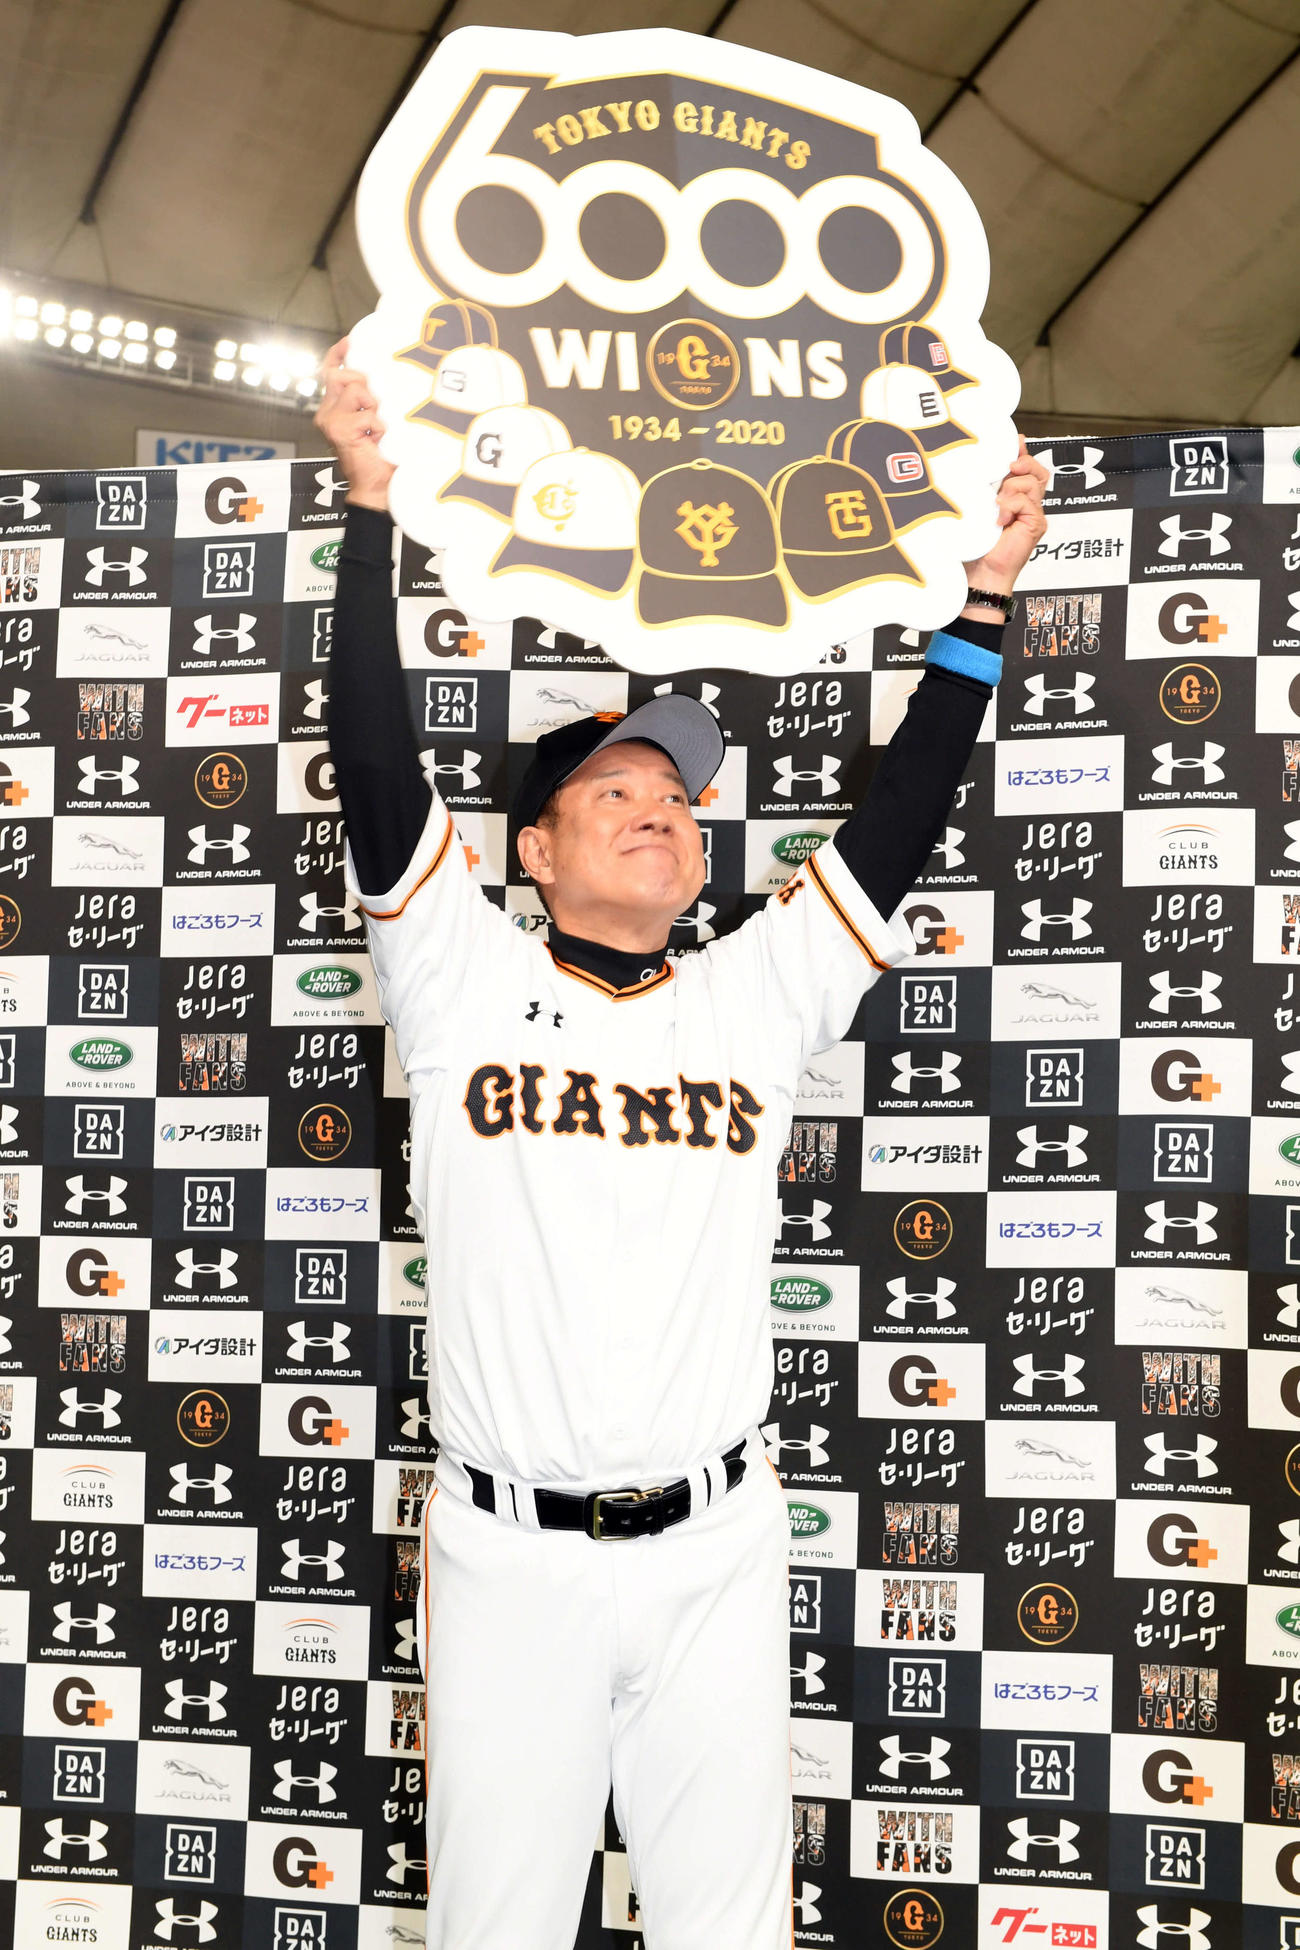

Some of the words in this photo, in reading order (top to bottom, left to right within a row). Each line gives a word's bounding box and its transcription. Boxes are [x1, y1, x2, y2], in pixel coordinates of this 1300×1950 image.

[533, 98, 660, 155] TOKYO
[673, 101, 811, 169] GIANTS
[418, 85, 935, 323] 6000
[608, 415, 682, 441] 1934
[715, 419, 785, 445] 2020
[1184, 447, 1216, 465] DA
[1185, 467, 1215, 486] ZN
[109, 486, 136, 502] DA
[108, 505, 135, 521] ZN
[1144, 564, 1186, 574] UNDER
[1189, 562, 1244, 572] ARMOUR
[73, 591, 108, 601] UNDER
[111, 592, 157, 600] ARMOUR
[1023, 594, 1102, 627] WITH
[1023, 627, 1102, 658] FANS
[73, 653, 150, 662] JAGUAR
[181, 660, 217, 669] UNDER
[220, 658, 266, 667] ARMOUR
[77, 684, 145, 712] WITH
[438, 686, 465, 703] DA
[1168, 687, 1177, 696] 19
[1203, 686, 1214, 695] 34
[230, 705, 269, 726] ネット
[438, 706, 464, 723] ZN
[77, 712, 145, 741] FANS
[1011, 722, 1051, 732] UNDER
[1055, 720, 1107, 729] ARMOUR
[1008, 768, 1110, 785] はごろもフーズ
[67, 800, 102, 809] UNDER
[105, 801, 150, 809] ARMOUR
[760, 803, 799, 812] UNDER
[803, 802, 852, 811] ARMOUR
[1169, 841, 1208, 850] CLUB
[69, 862, 145, 871] JAGUAR
[1160, 855, 1217, 869] GIANTS
[173, 914, 262, 929] はごろもフーズ
[91, 973, 117, 990] DA
[309, 970, 341, 983] LAND
[310, 979, 352, 993] ROVER
[90, 993, 116, 1009] ZN
[915, 986, 944, 1003] DA
[293, 1010, 320, 1018] ABOVE
[332, 1009, 364, 1018] BEYOND
[914, 1006, 942, 1023] ZN
[1010, 1013, 1102, 1024] JAGUAR
[1136, 1020, 1177, 1030] UNDER
[1181, 1020, 1235, 1030] ARMOUR
[81, 1043, 114, 1055] LAND
[179, 1033, 248, 1062] WITH
[81, 1052, 123, 1065] ROVER
[179, 1062, 248, 1091] FANS
[66, 1081, 92, 1089] ABOVE
[96, 1081, 100, 1089] &
[103, 1081, 135, 1089] BEYOND
[464, 1061, 765, 1156] GIANTS
[179, 1124, 262, 1141] アイダ設計
[305, 1125, 313, 1134] 19
[336, 1125, 346, 1134] 34
[1169, 1133, 1200, 1151] DA
[889, 1145, 982, 1163] アイダ設計
[1168, 1154, 1198, 1172] ZN
[196, 1186, 223, 1202] DA
[277, 1198, 368, 1212] はごろもフーズ
[196, 1206, 222, 1222] ZN
[53, 1220, 89, 1229] UNDER
[92, 1221, 137, 1231] ARMOUR
[902, 1222, 911, 1231] 19
[936, 1222, 946, 1231] 34
[1000, 1221, 1102, 1238] はごろもフーズ
[308, 1258, 335, 1275] DA
[308, 1278, 334, 1295] ZN
[775, 1281, 811, 1295] LAND
[776, 1292, 821, 1306] ROVER
[873, 1325, 913, 1335] UNDER
[917, 1326, 968, 1335] ARMOUR
[1136, 1319, 1227, 1330] JAGUAR
[173, 1338, 256, 1356] アイダ設計
[1141, 1352, 1221, 1386] WITH
[1141, 1386, 1221, 1418] FANS
[72, 1481, 105, 1490] CLUB
[1132, 1482, 1174, 1492] UNDER
[1177, 1485, 1231, 1495] ARMOUR
[64, 1493, 113, 1508] GIANTS
[157, 1508, 193, 1518] UNDER
[197, 1510, 243, 1520] ARMOUR
[155, 1554, 245, 1571] はごろもフーズ
[880, 1578, 957, 1611] WITH
[880, 1611, 957, 1643] FANS
[294, 1635, 328, 1645] CLUB
[40, 1647, 76, 1657] UNDER
[79, 1650, 126, 1659] ARMOUR
[285, 1648, 336, 1663] GIANTS
[903, 1668, 933, 1686] DA
[902, 1689, 932, 1707] ZN
[995, 1683, 1098, 1701] はごろもフーズ
[66, 1755, 93, 1773] DA
[66, 1775, 92, 1793] ZN
[866, 1785, 907, 1794] UNDER
[910, 1787, 963, 1796] ARMOUR
[154, 1791, 231, 1802] JAGUAR
[261, 1806, 297, 1816] UNDER
[300, 1810, 347, 1819] ARMOUR
[877, 1809, 953, 1841] WITH
[1160, 1835, 1192, 1856] DA
[877, 1841, 953, 1874] FANS
[1160, 1857, 1191, 1878] ZN
[56, 1914, 89, 1924] CLUB
[47, 1927, 97, 1942] GIANTS
[1052, 1923, 1097, 1948] ネット
